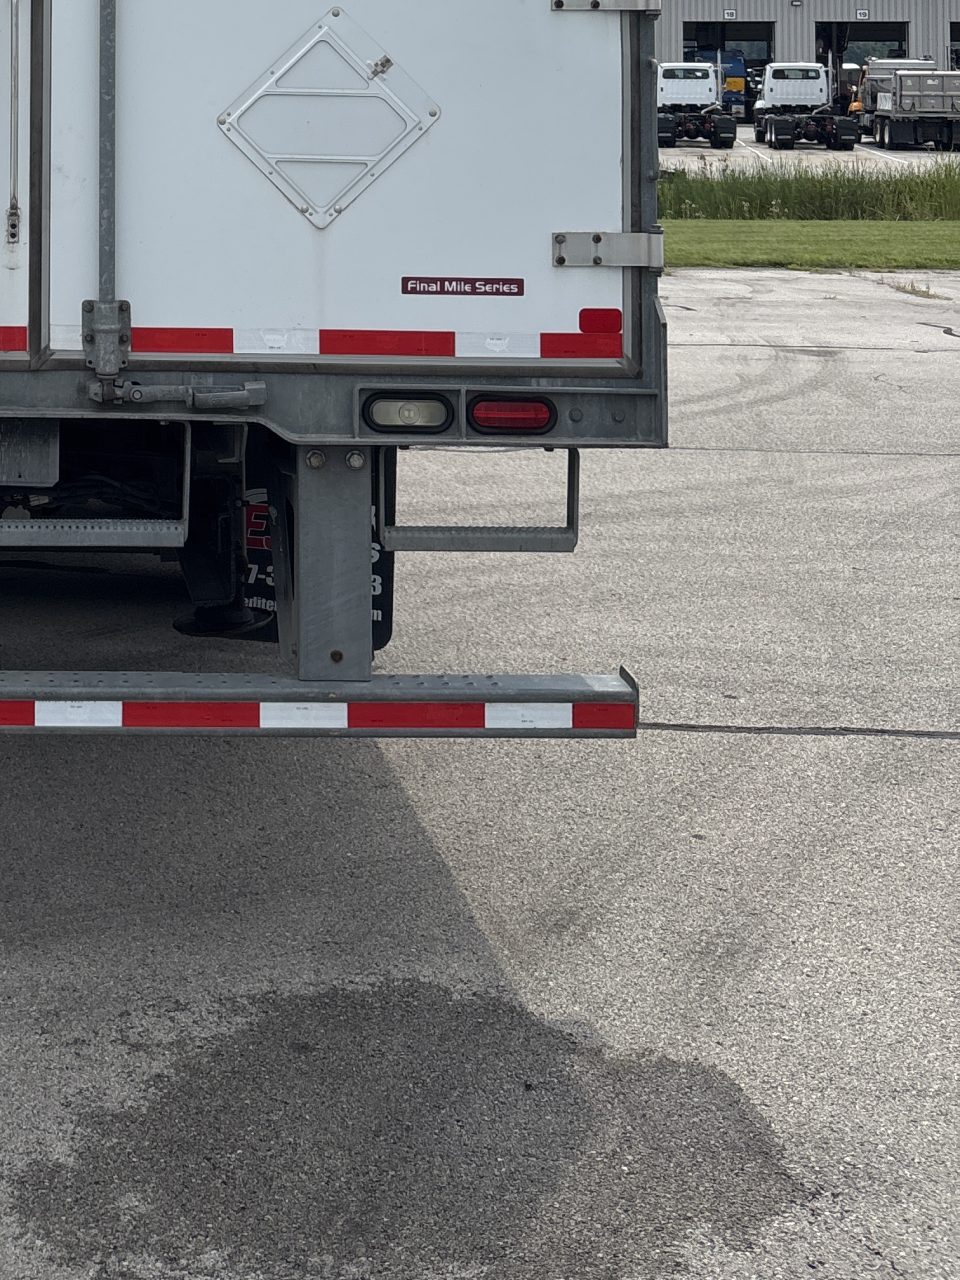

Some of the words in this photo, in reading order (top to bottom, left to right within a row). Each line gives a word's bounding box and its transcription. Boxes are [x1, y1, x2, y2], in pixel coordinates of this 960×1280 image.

[407, 280, 440, 292] Final
[444, 281, 472, 293] Mile
[475, 281, 518, 293] Series
